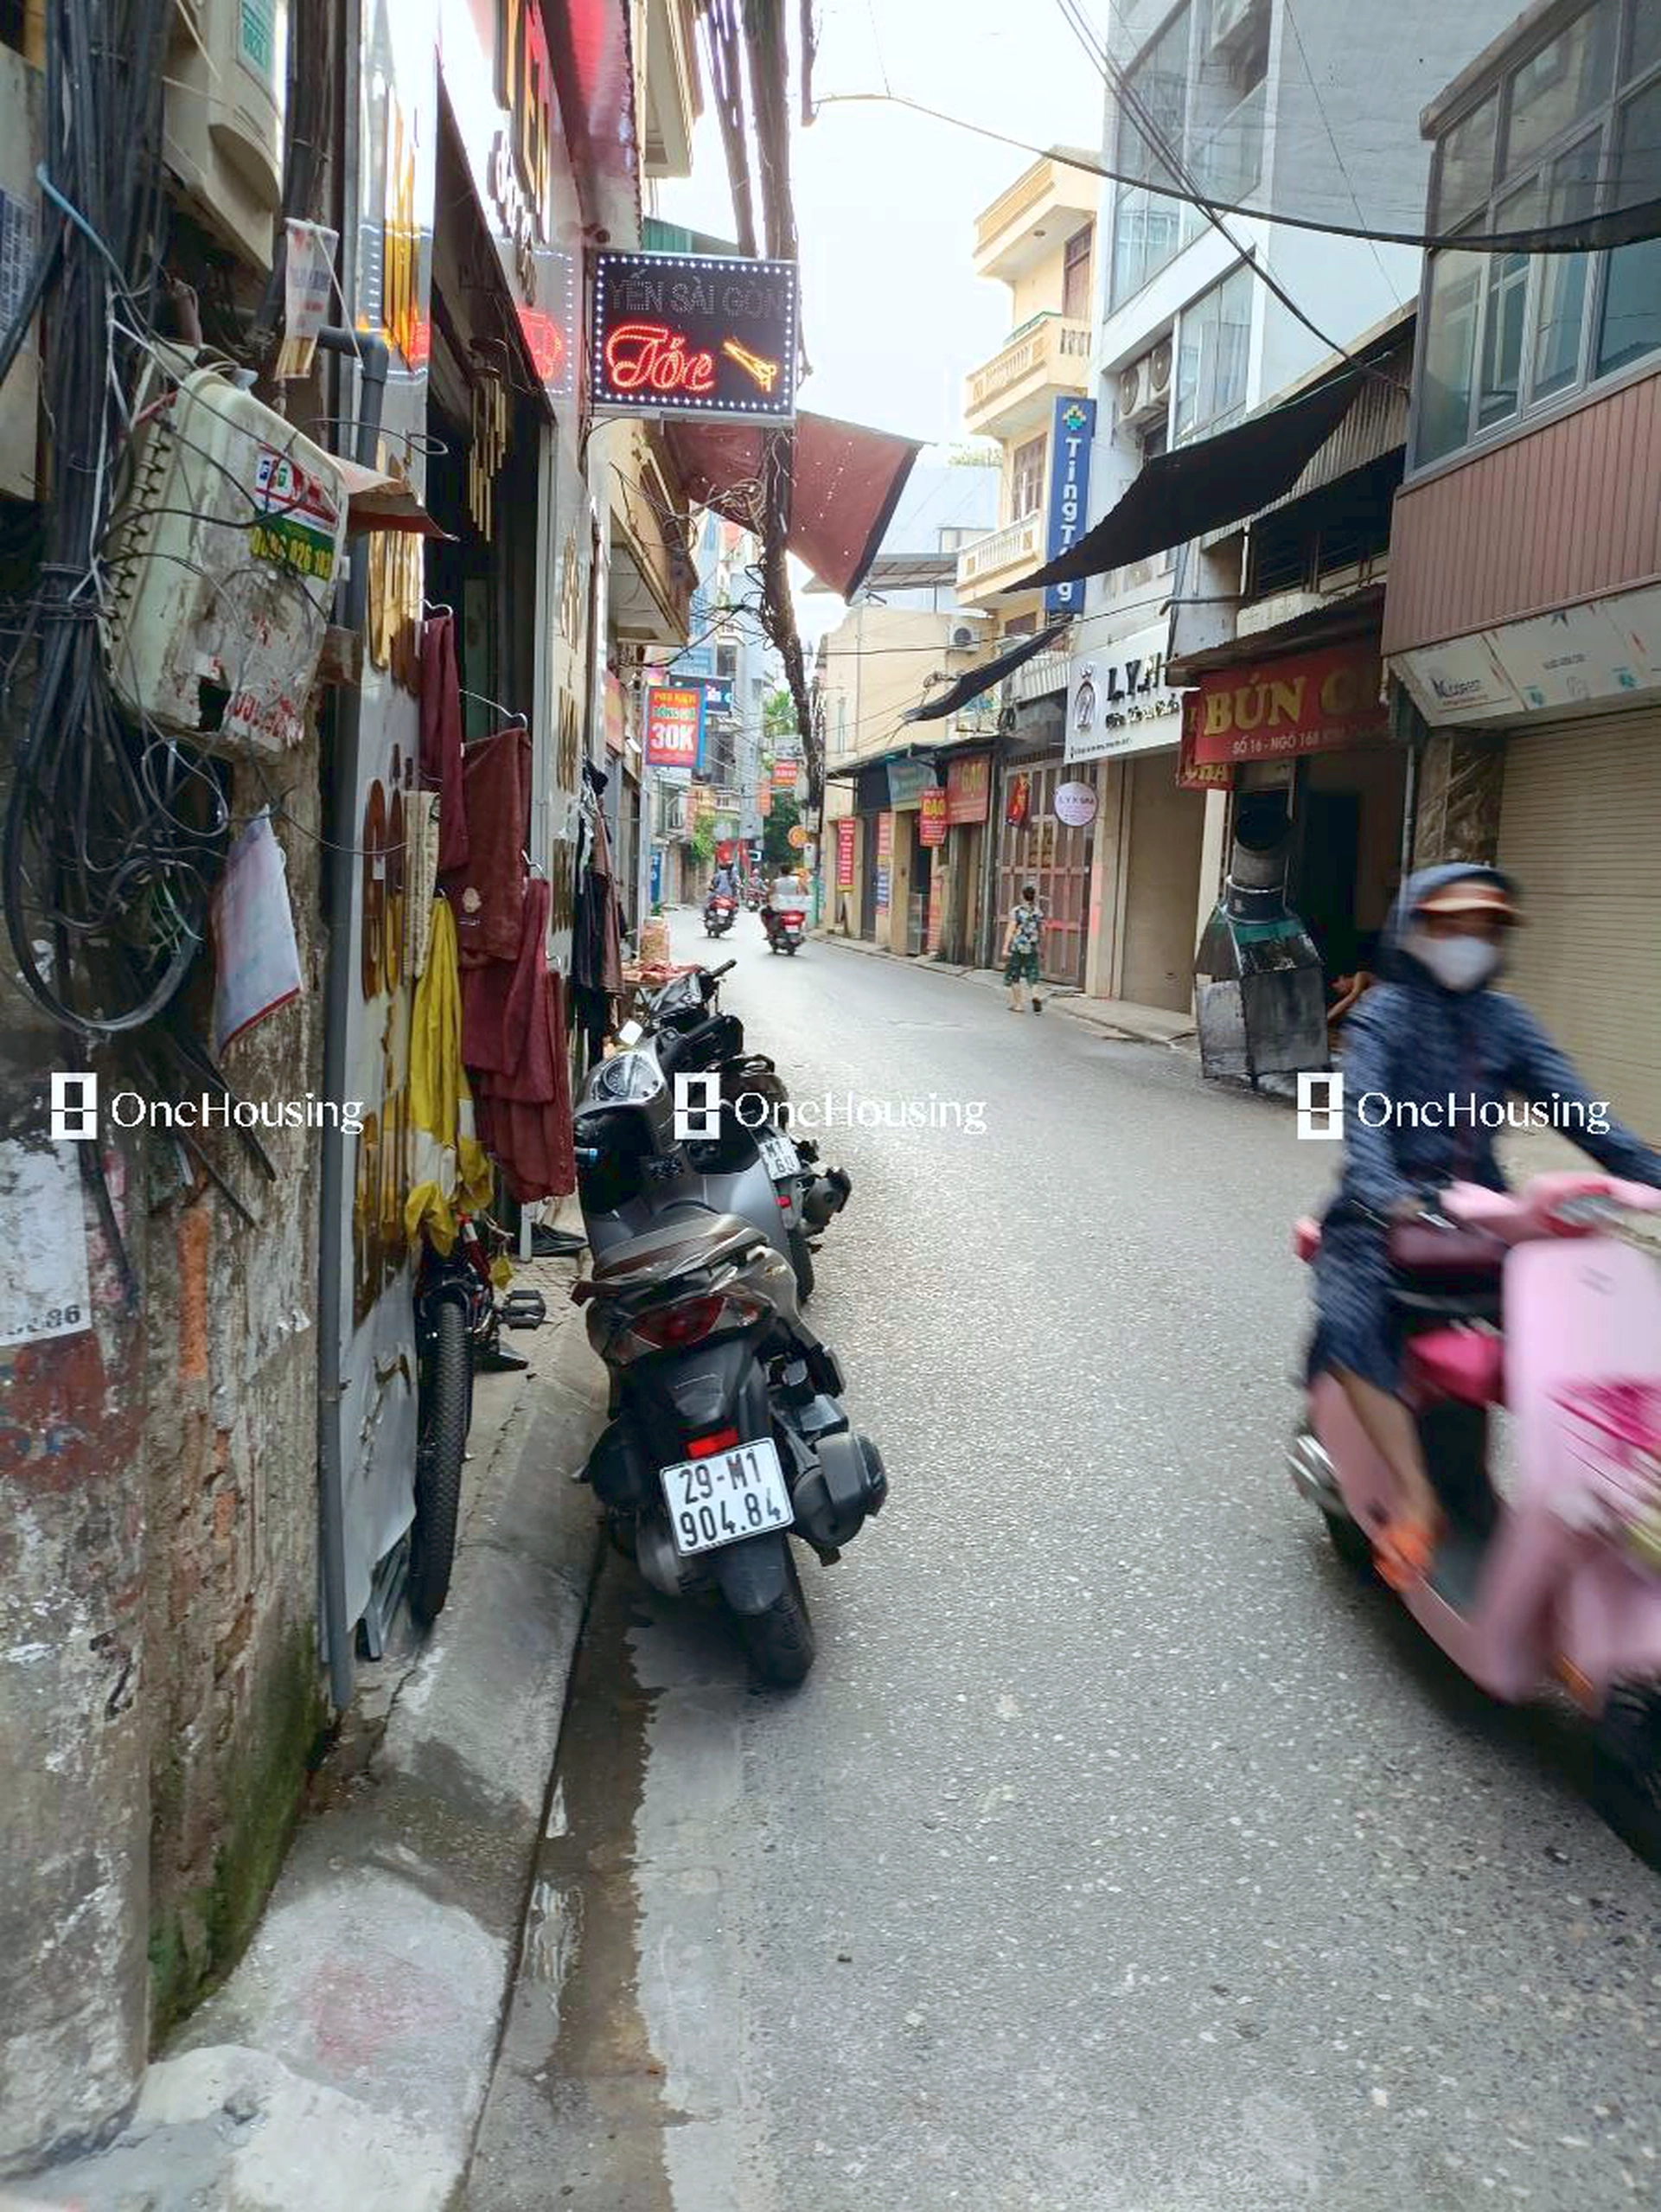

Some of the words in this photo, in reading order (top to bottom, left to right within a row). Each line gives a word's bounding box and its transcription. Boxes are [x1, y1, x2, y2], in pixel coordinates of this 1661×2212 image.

[1057, 437, 1083, 601] TingTg
[650, 723, 694, 751] 30K
[679, 1449, 761, 1505] 29-M1
[680, 1487, 781, 1546] 904.84
